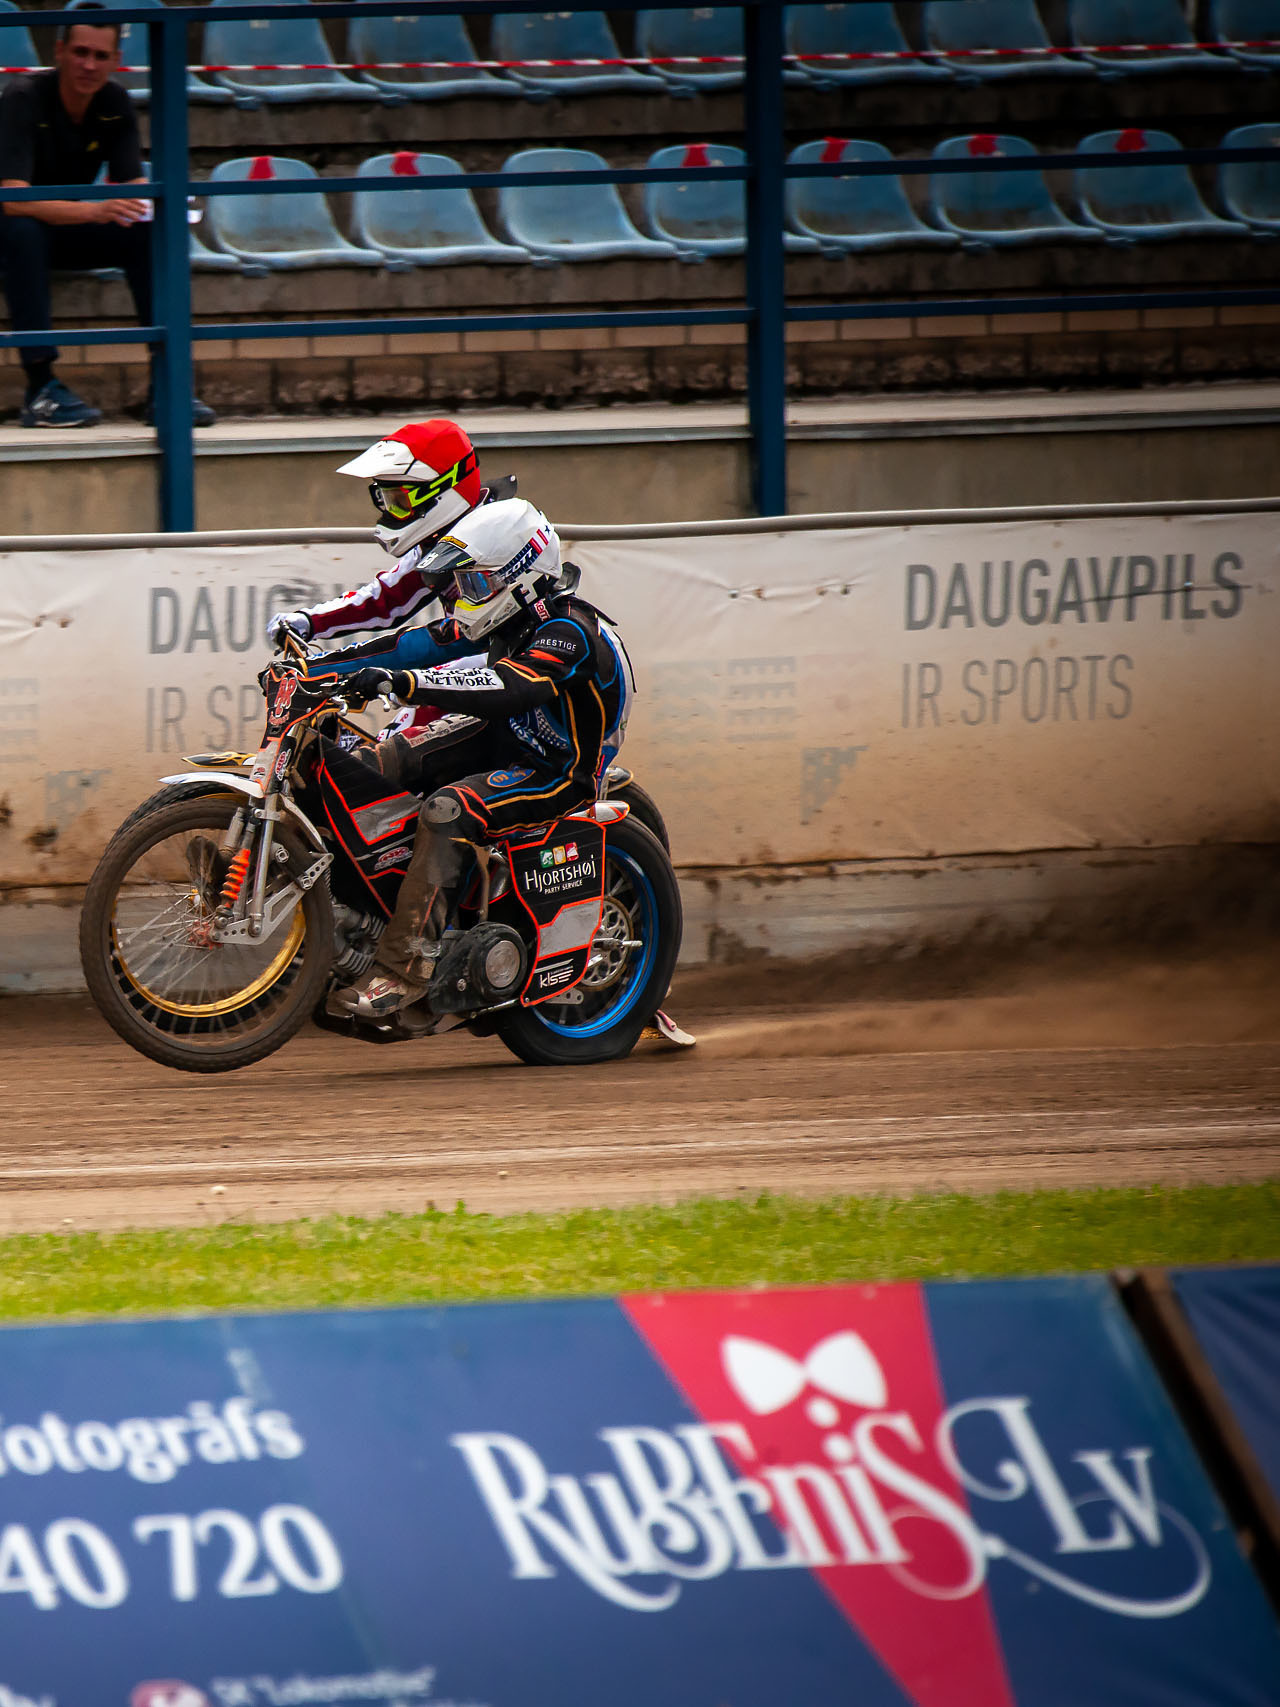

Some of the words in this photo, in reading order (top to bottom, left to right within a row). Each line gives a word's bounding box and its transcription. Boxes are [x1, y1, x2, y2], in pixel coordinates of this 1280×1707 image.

[904, 552, 1245, 631] DAUGAVPILS
[425, 674, 497, 688] NETWORK
[900, 662, 943, 729] IR
[960, 653, 1136, 726] SPORTS
[145, 687, 187, 753] IR
[133, 1503, 344, 1601] 720
